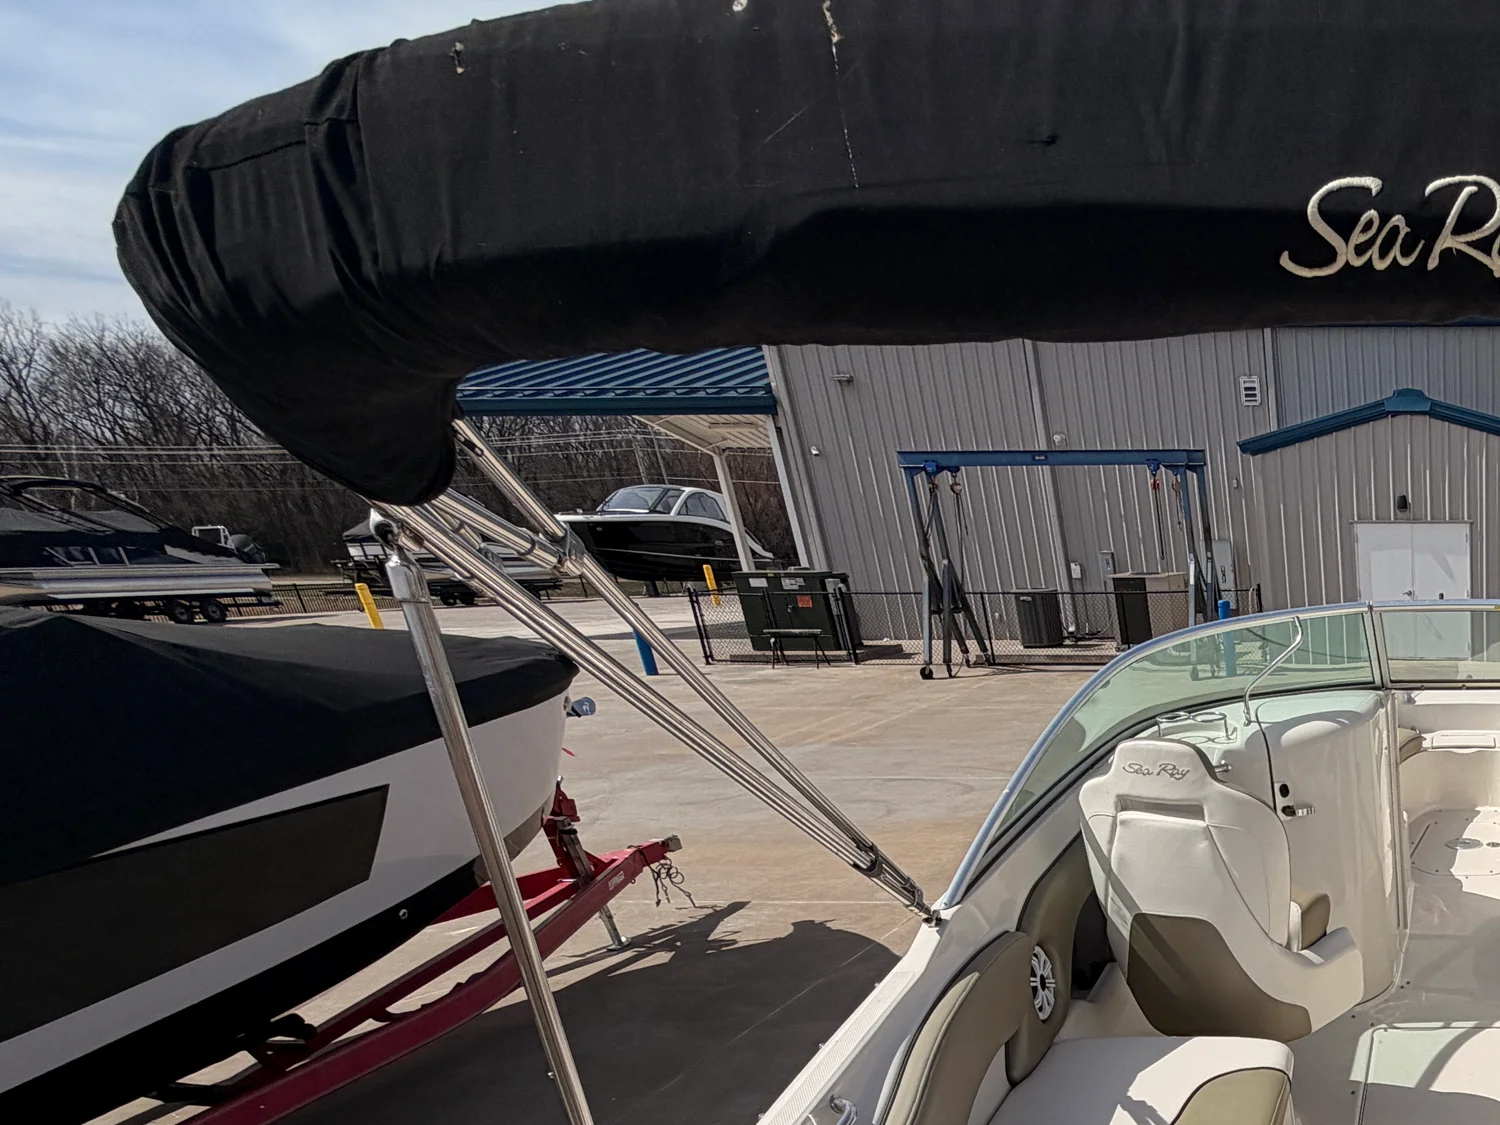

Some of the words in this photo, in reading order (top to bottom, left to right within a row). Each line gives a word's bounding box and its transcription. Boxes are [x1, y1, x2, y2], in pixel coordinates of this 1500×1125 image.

[1279, 176, 1426, 277] Sea
[1122, 762, 1153, 776] Sea
[1156, 762, 1190, 780] Ray
